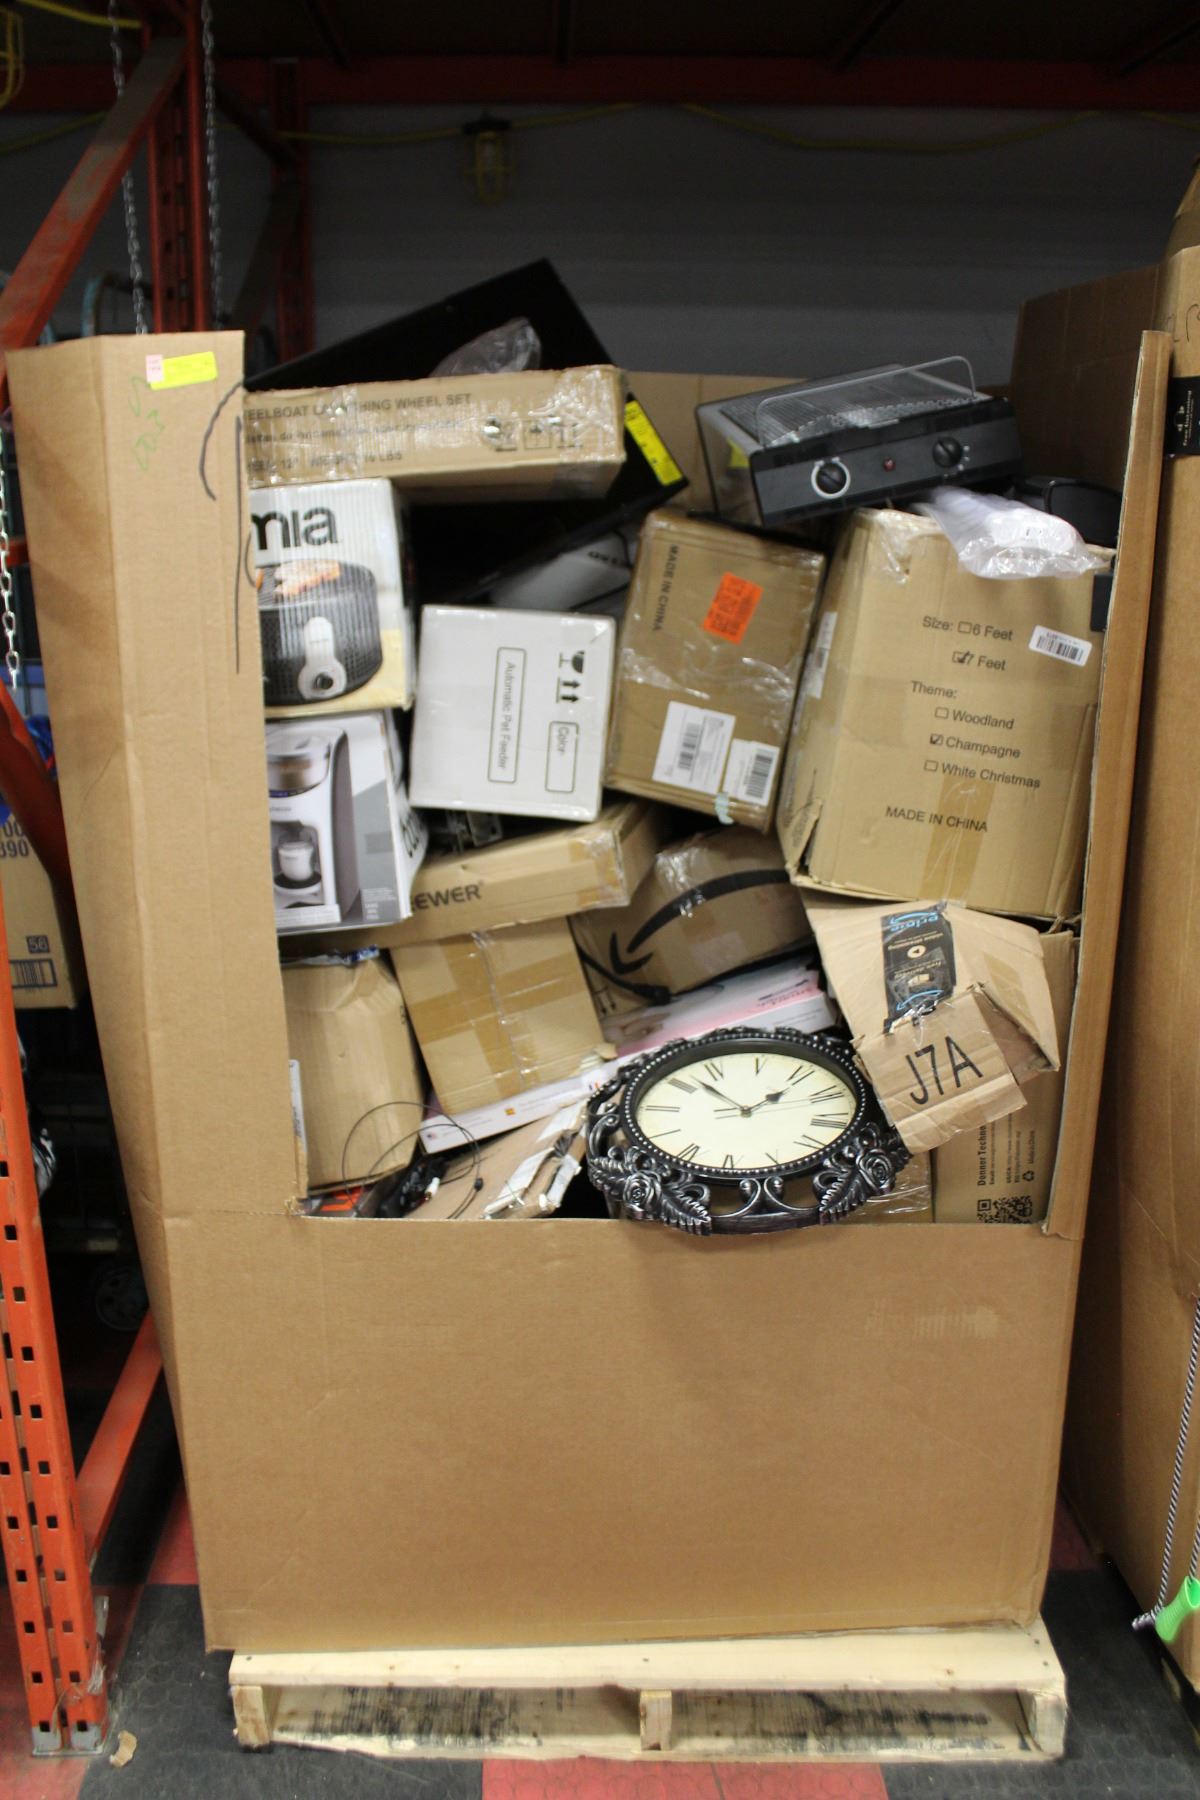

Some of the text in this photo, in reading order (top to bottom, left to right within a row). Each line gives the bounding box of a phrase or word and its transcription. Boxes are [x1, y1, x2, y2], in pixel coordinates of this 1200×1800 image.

[245, 405, 309, 420] EELBOAT
[396, 398, 442, 410] WHEEL
[446, 394, 473, 406] SET
[663, 545, 678, 578] MADE
[922, 616, 1013, 641] Size: 6 Feet
[977, 656, 1006, 671] Feet
[911, 681, 957, 699] Theme:
[952, 709, 1015, 730] Woodland
[946, 736, 1021, 758] Champagne
[941, 762, 1041, 789] White Christmas
[885, 806, 988, 832] MADE IN CHINA
[413, 884, 482, 910] EWER
[905, 1036, 983, 1104] J7A
